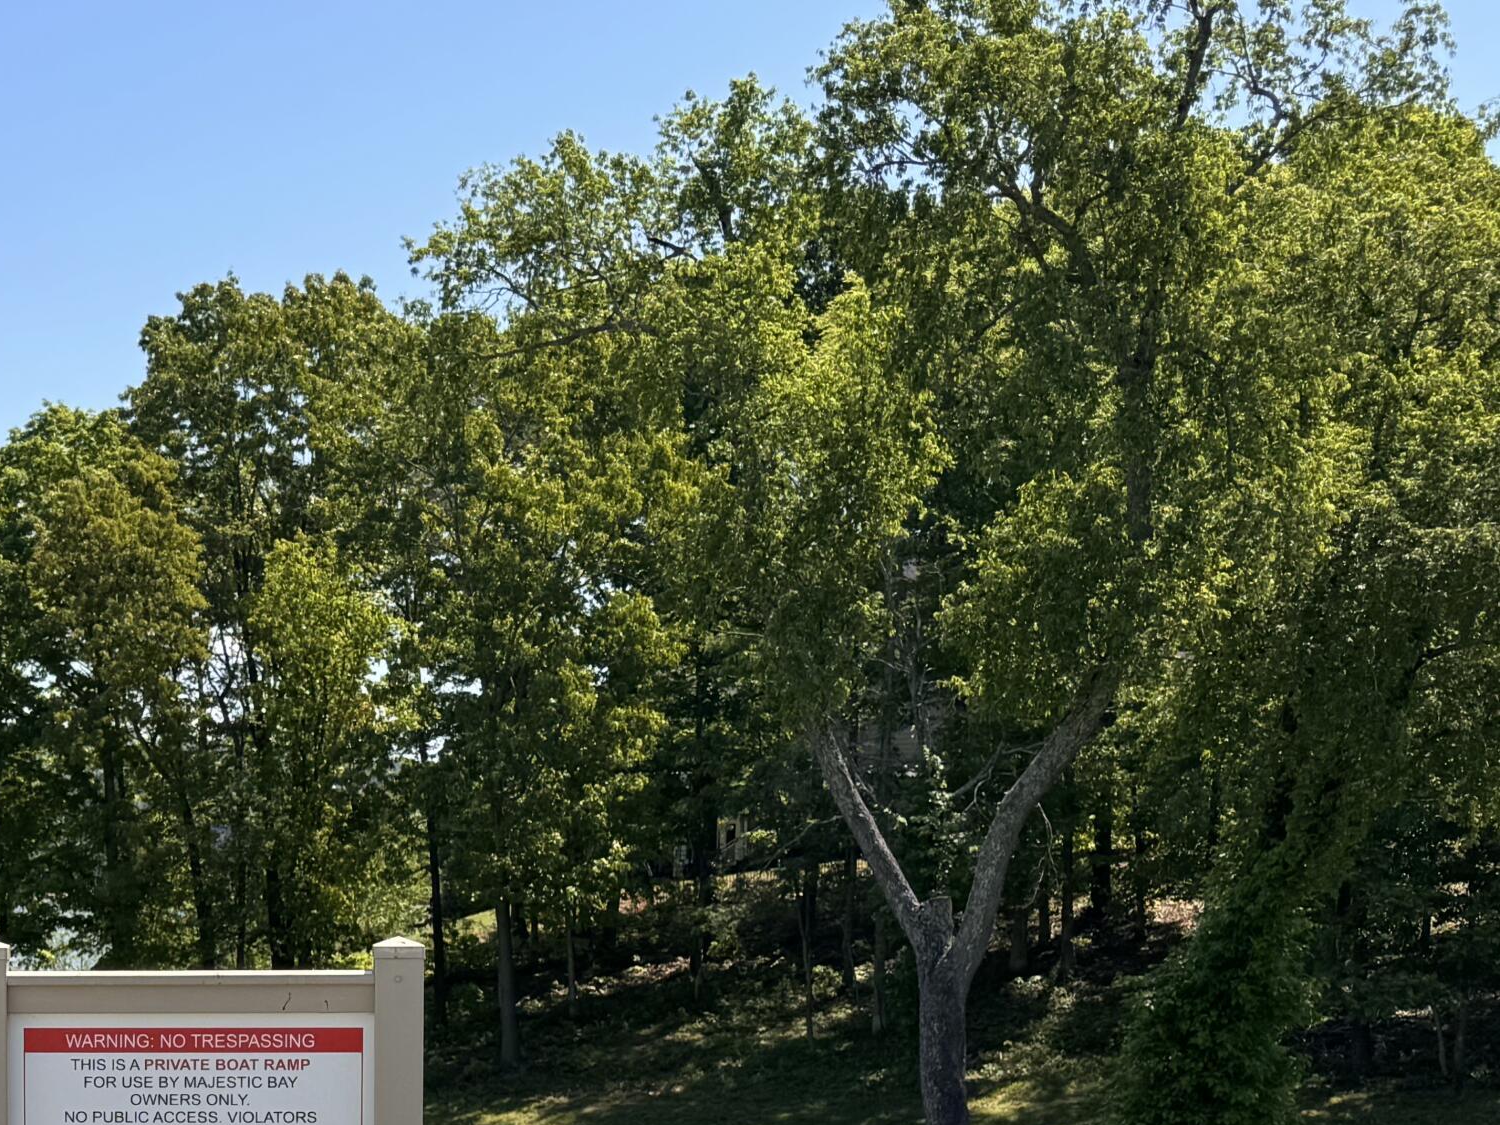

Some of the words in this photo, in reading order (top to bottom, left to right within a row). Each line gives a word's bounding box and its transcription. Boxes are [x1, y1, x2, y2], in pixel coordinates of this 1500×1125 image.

[66, 1034, 154, 1049] WARNING:
[160, 1034, 186, 1049] NO
[191, 1034, 315, 1049] TRESPASSING
[71, 1058, 108, 1071] THIS
[112, 1058, 126, 1071] IS
[129, 1058, 140, 1071] A
[144, 1058, 210, 1071] PRIVATE
[216, 1058, 258, 1071] BOAT
[264, 1058, 310, 1071] RAMP
[84, 1076, 117, 1089] FOR
[122, 1076, 153, 1089] USE
[158, 1076, 179, 1089] BY
[184, 1076, 262, 1089] MAJESTIC
[268, 1076, 297, 1089] BAY
[130, 1093, 201, 1106] OWNERS
[206, 1093, 250, 1106] ONLY.
[64, 1111, 88, 1124] NO
[93, 1111, 149, 1124] PUBLIC
[153, 1111, 222, 1124] ACCESS.
[228, 1111, 317, 1124] VIOLATORS
